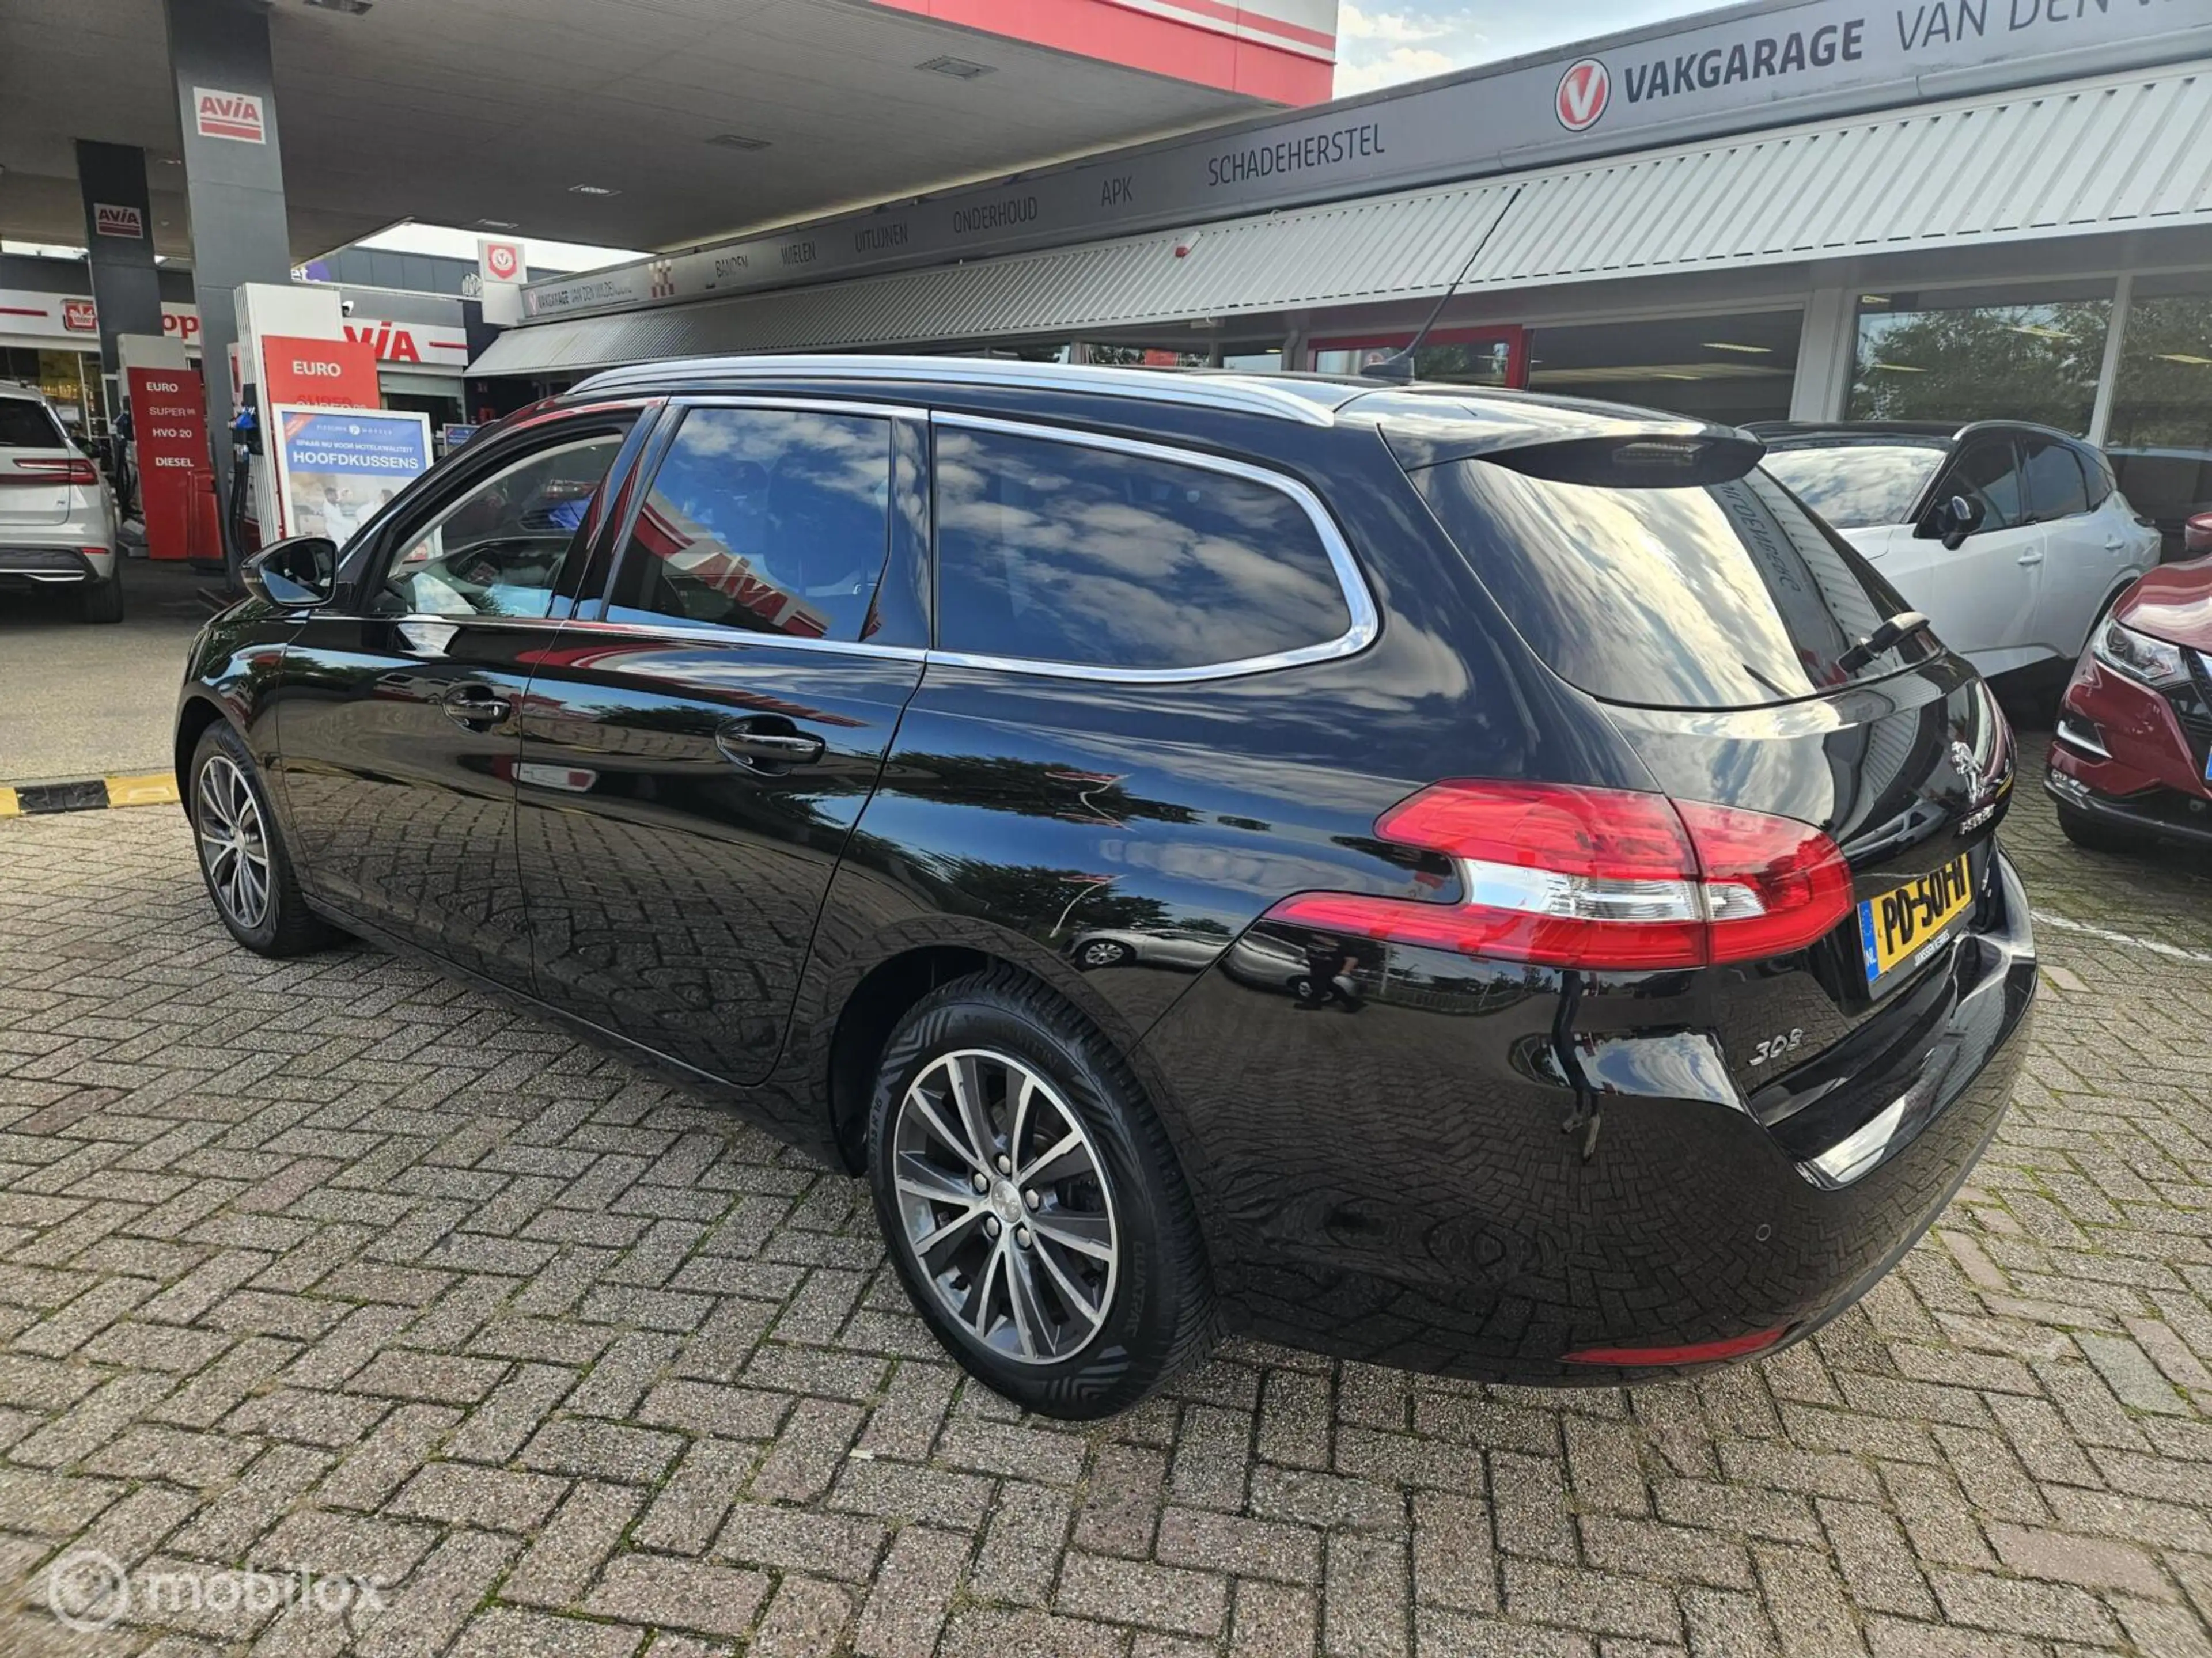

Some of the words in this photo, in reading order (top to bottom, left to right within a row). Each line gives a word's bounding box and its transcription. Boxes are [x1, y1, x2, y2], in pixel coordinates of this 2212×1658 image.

[1624, 18, 1866, 104] VAKGARAGE
[1897, 0, 1987, 51] VAN
[1208, 123, 1385, 187] SCHADEHERSTEL
[1101, 176, 1133, 207] APK
[953, 196, 1037, 234] ONDERHOUD
[292, 360, 342, 377] EURO
[146, 382, 179, 393] EURO
[149, 407, 187, 416] SUPER
[152, 428, 177, 438] HVO
[180, 428, 192, 438] 20
[155, 457, 195, 468] DIESEL
[293, 450, 419, 469] HOOFDKUSSENS
[1748, 1027, 1804, 1066] 308
